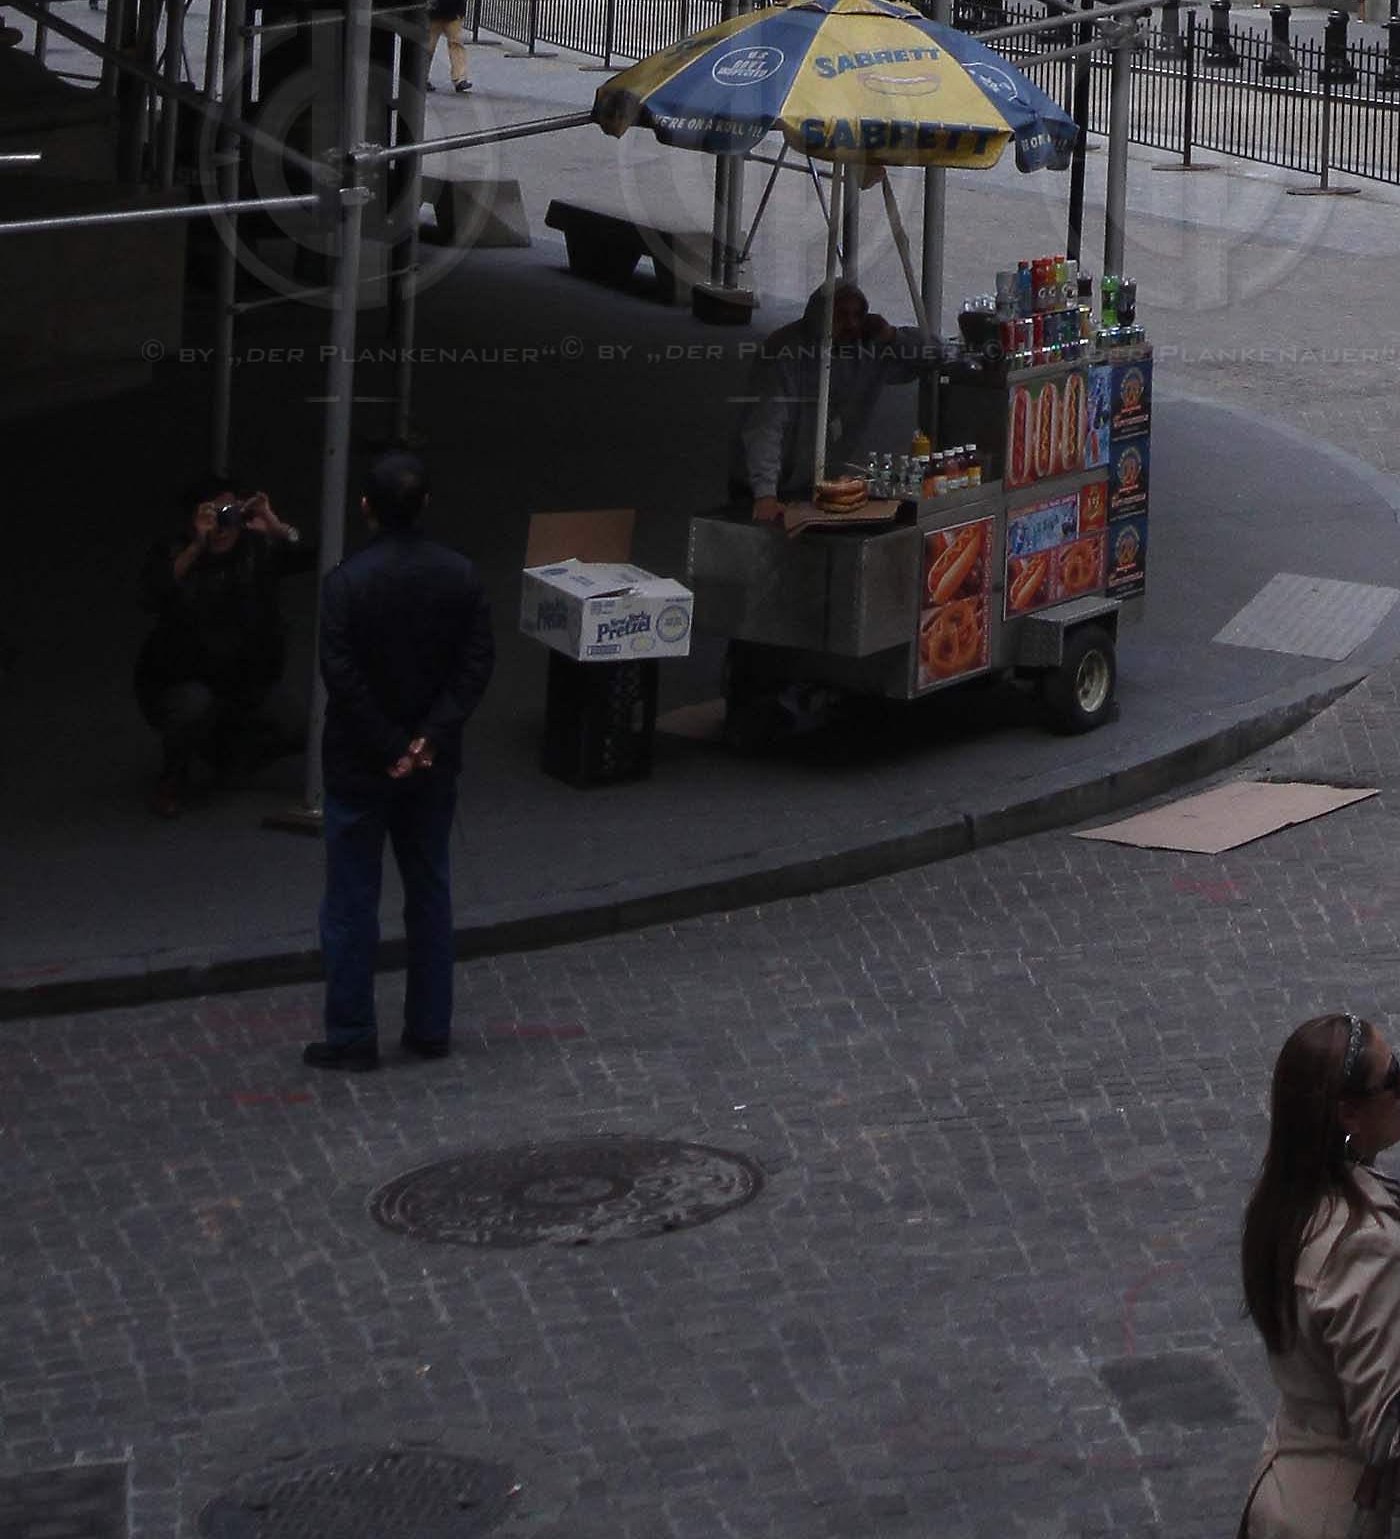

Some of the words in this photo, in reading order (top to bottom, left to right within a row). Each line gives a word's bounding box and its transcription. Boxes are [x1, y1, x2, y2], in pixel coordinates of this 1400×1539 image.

[813, 46, 941, 79] SABRETT
[798, 117, 999, 156] SABRETT
[596, 613, 652, 644] Pretzel
